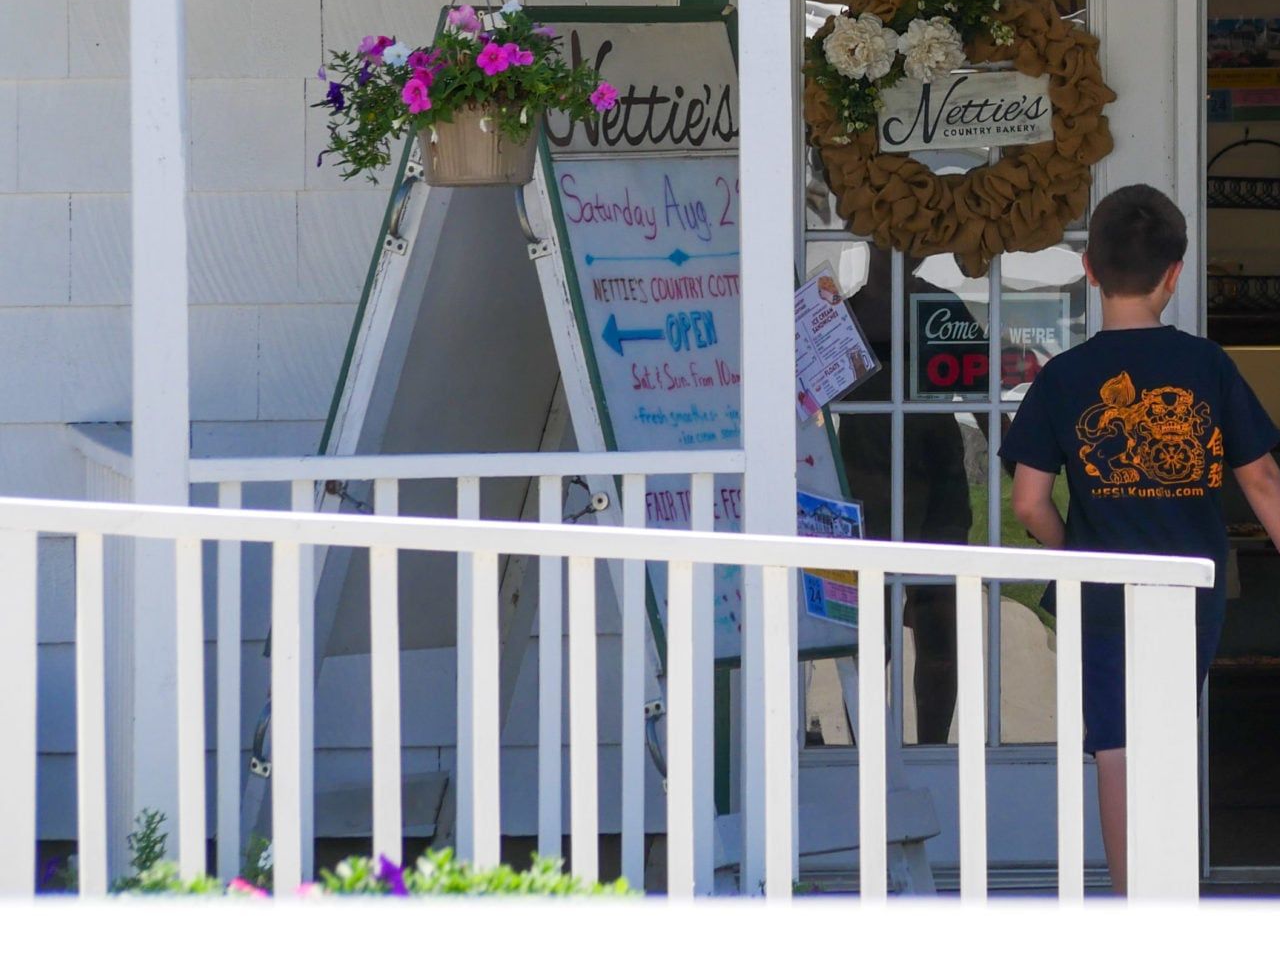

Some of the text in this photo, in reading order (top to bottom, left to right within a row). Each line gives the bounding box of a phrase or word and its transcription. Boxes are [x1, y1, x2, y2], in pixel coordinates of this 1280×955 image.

[883, 76, 1048, 145] Nettie's
[943, 124, 1036, 138] COUNTRY BAKERY
[560, 173, 658, 241] Saturday
[593, 278, 648, 304] NETTIE'S
[650, 275, 704, 303] COUNTRY
[666, 309, 718, 353] OPEN
[925, 308, 979, 341] Come
[1009, 327, 1056, 344] WE'RE
